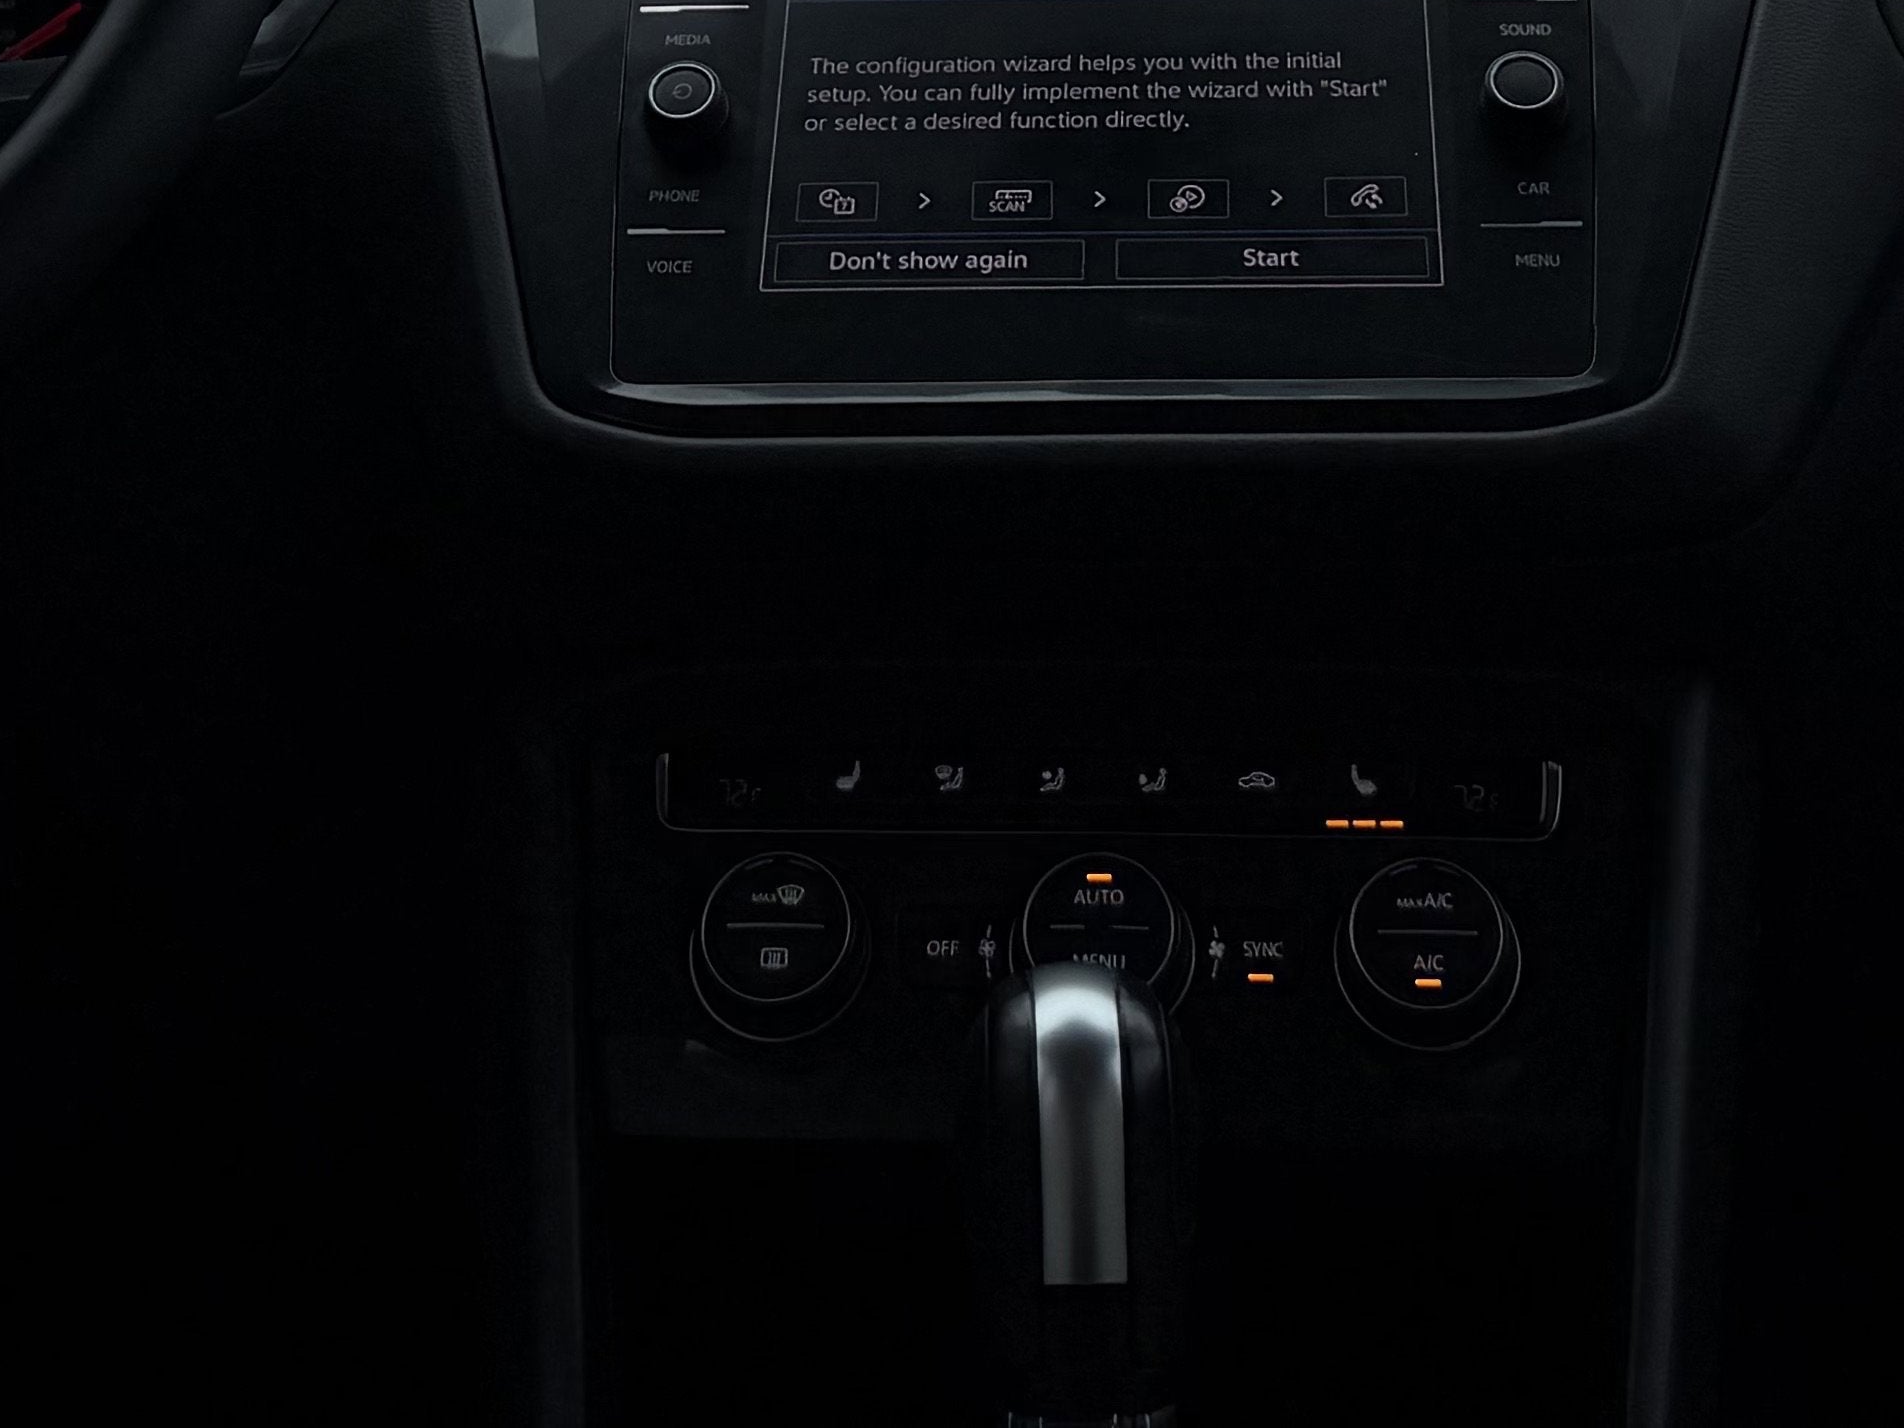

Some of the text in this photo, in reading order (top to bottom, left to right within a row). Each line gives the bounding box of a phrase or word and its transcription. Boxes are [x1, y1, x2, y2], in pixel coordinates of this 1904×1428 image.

[1498, 23, 1553, 37] SOUND
[664, 33, 712, 47] MEDIA
[810, 50, 1342, 78] The configuration wizard helps you with the initial
[807, 79, 1389, 107] setup. You can fully implement the wizard with "Start"
[804, 110, 1191, 134] or select a desired function directly.
[648, 189, 701, 203] PHONE
[1516, 181, 1551, 196] CAR
[988, 199, 1027, 214] SCAN
[645, 259, 694, 274] VOICE
[828, 249, 1029, 275] Don't show again
[1242, 247, 1301, 268] Start
[1514, 253, 1562, 268] MENU
[1072, 888, 1126, 906] AUTO
[926, 939, 960, 957] OFF
[1242, 940, 1284, 959] SYNC
[1413, 953, 1444, 972] A/C
